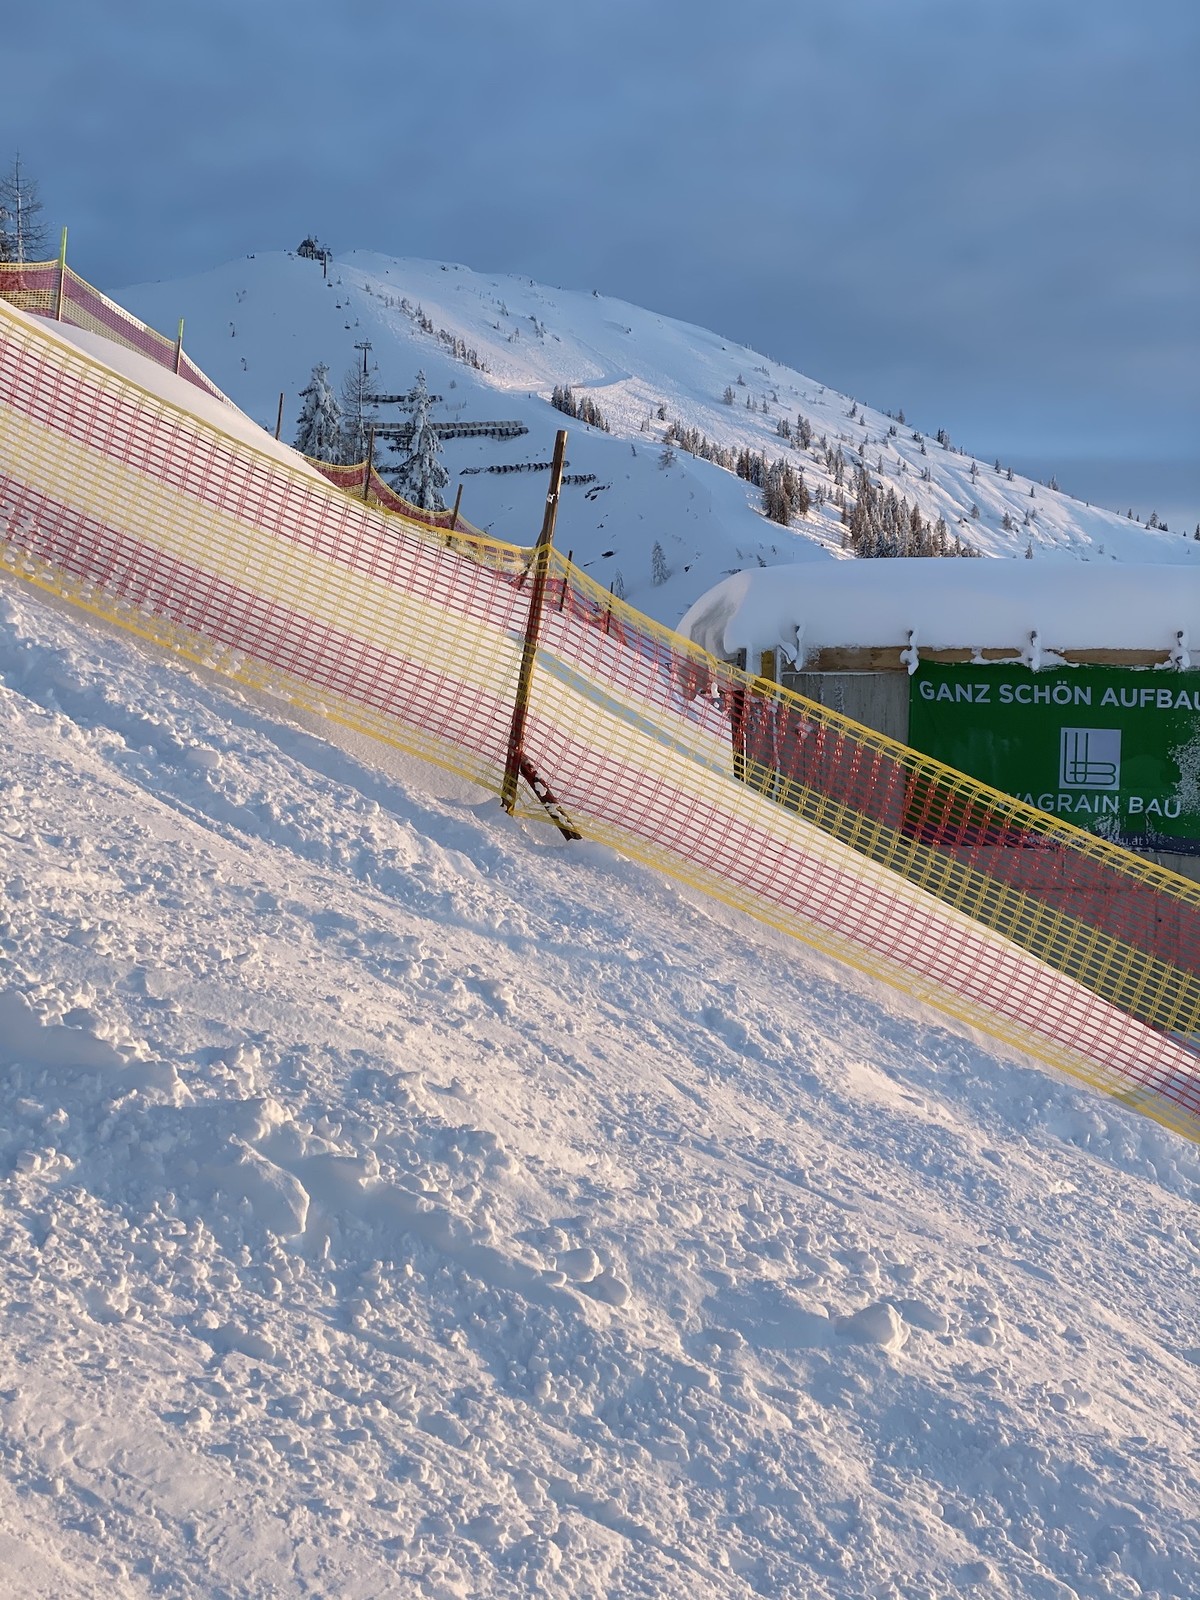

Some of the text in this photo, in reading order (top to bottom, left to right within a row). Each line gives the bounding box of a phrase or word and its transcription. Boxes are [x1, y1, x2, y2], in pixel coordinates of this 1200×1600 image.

[919, 680, 991, 703] GANZ
[999, 680, 1092, 706] SCHÖN
[1128, 796, 1182, 819] BAU
